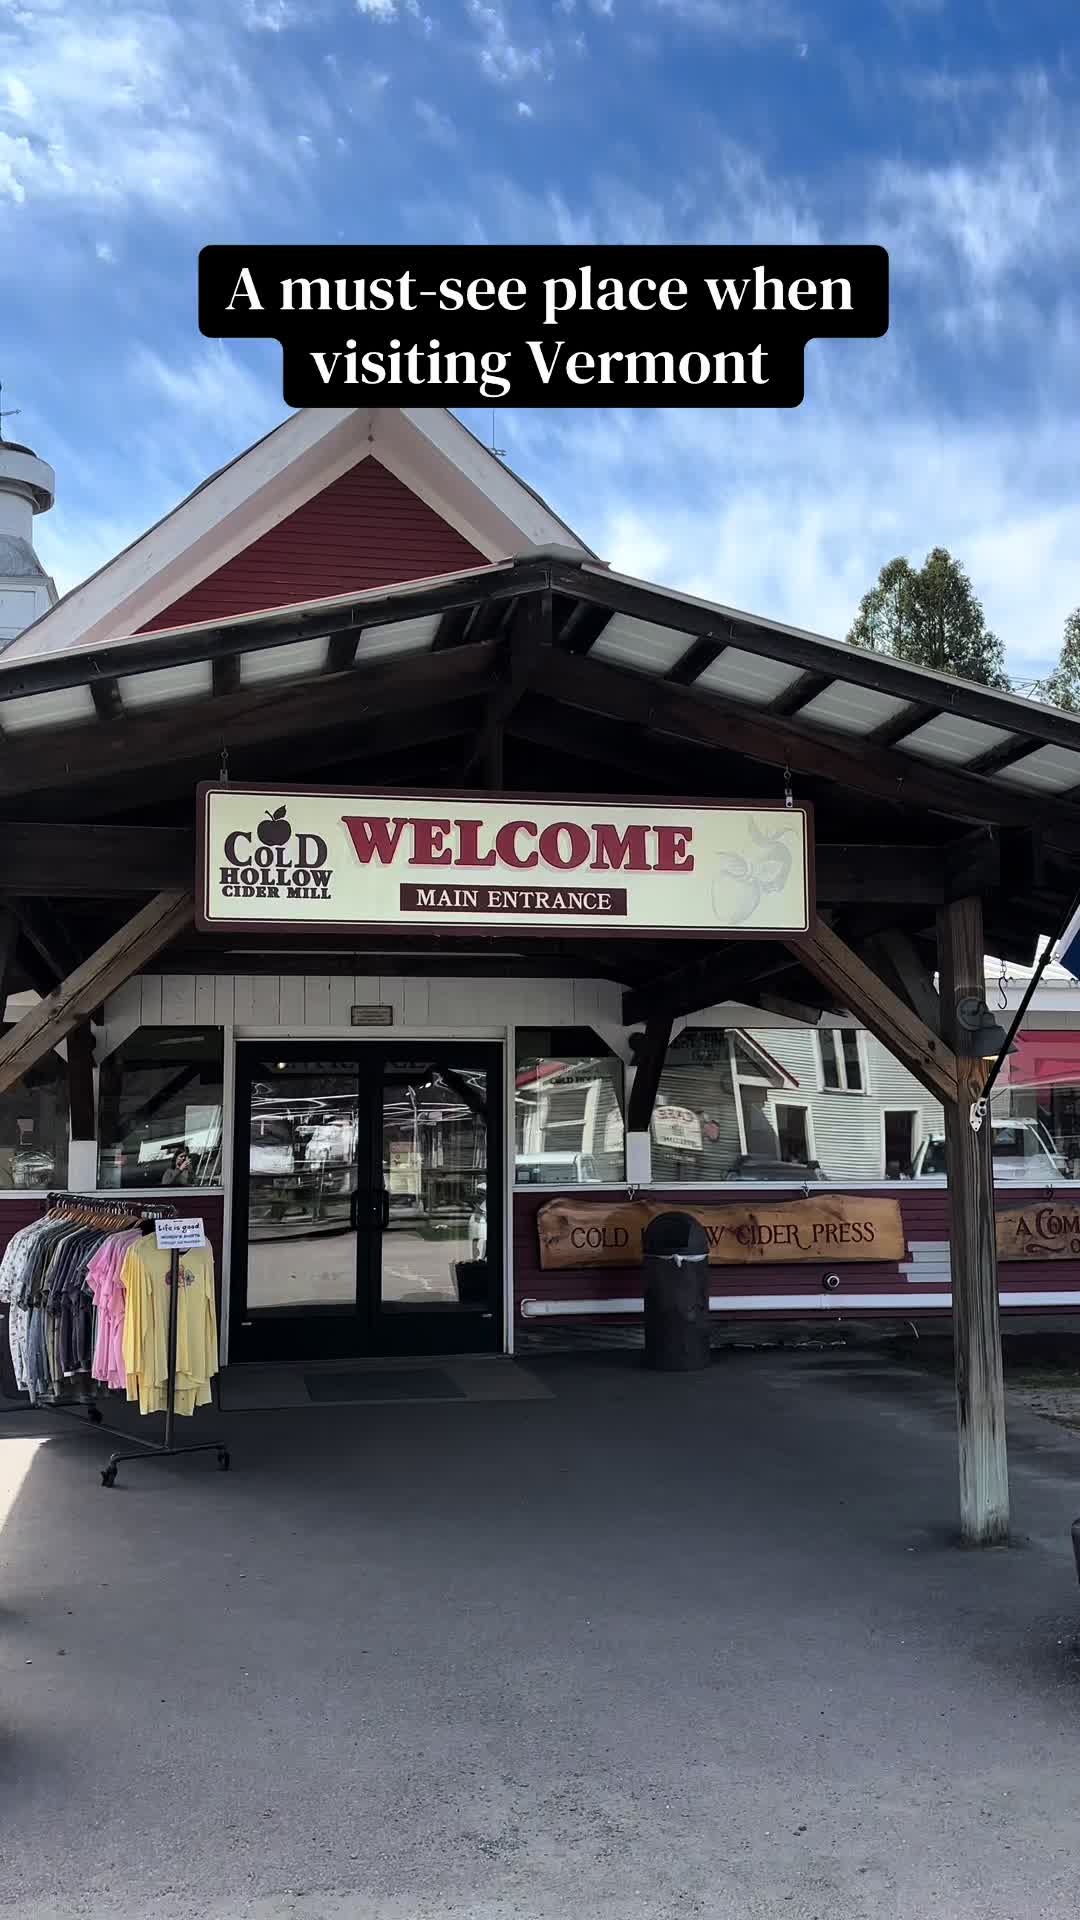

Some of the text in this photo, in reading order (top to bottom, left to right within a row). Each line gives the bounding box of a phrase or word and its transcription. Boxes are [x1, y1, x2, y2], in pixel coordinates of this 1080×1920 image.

[224, 830, 328, 868] COLD
[341, 815, 695, 872] WELCOME
[219, 867, 333, 887] HOLLOW
[222, 885, 332, 899] CIDER MILL
[416, 888, 612, 911] MAIN ENTRANCE
[182, 1223, 200, 1233] good
[571, 1226, 629, 1249] COLD
[735, 1223, 812, 1250] CIDER
[812, 1221, 876, 1244] PRESS
[1016, 1215, 1032, 1236] A
